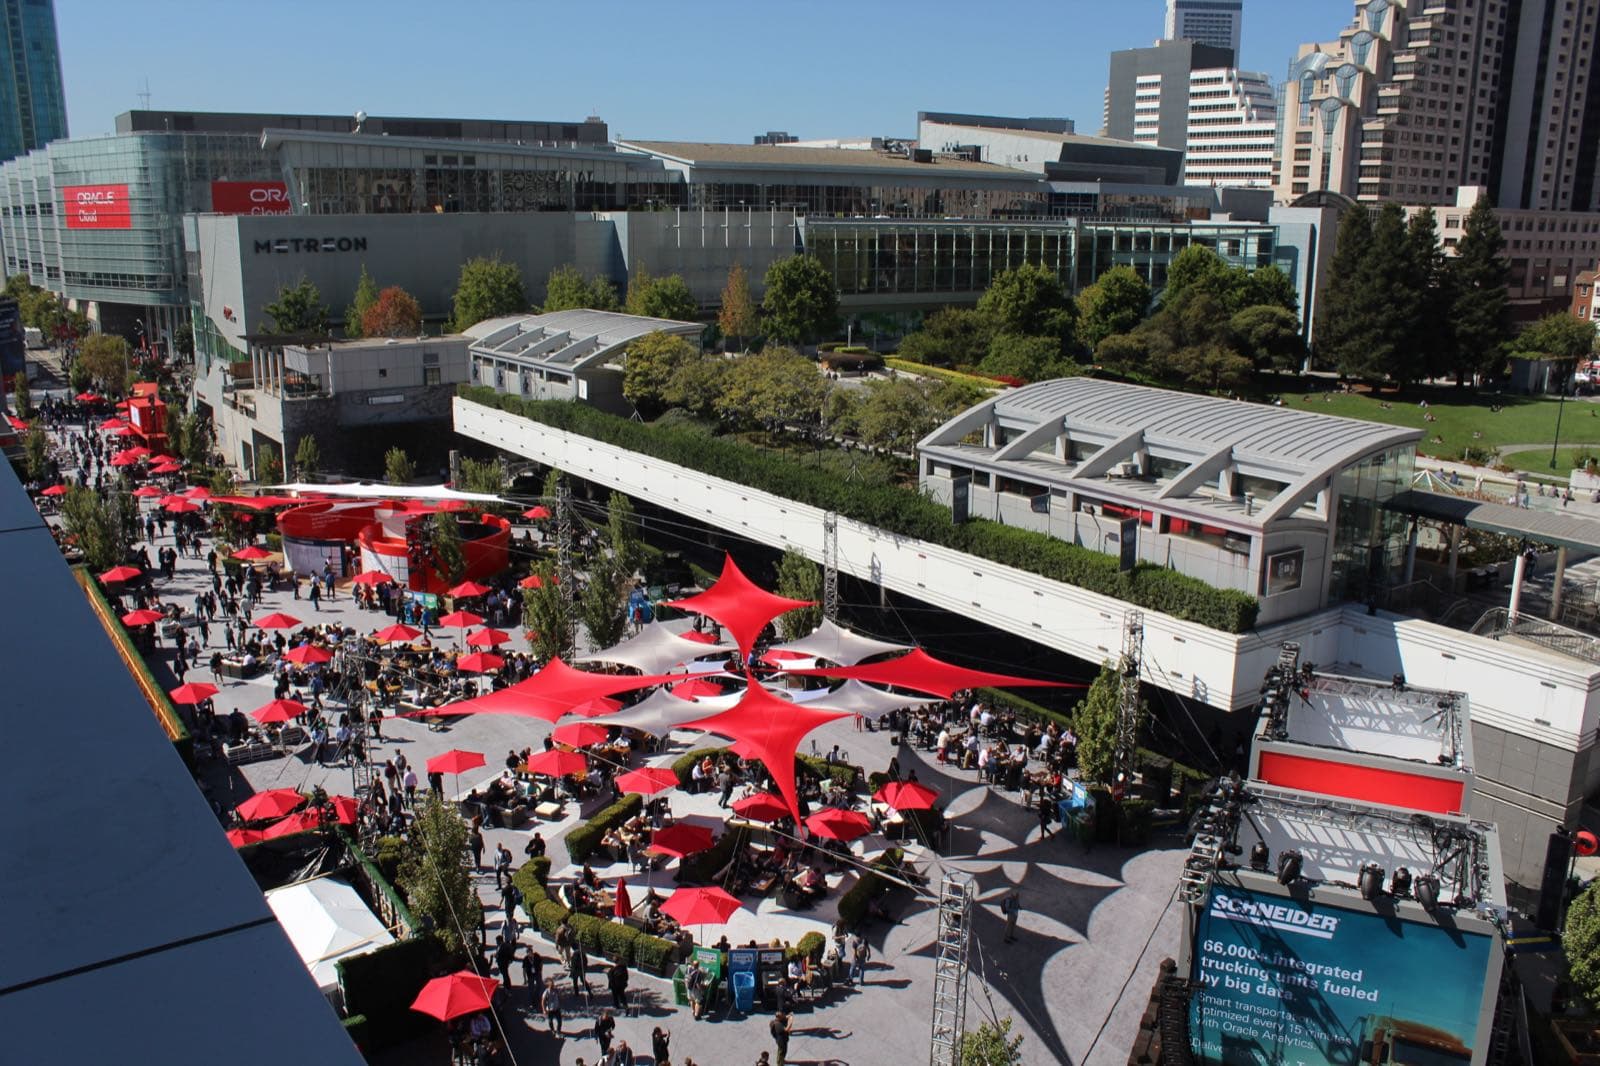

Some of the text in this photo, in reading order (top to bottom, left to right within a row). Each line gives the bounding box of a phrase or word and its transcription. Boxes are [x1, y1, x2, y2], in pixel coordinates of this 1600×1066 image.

[77, 191, 114, 204] ORACLE
[255, 237, 367, 254] METREON
[1213, 894, 1337, 931] SCHNEIDER
[1203, 939, 1363, 982] 66,000+ integrated
[1200, 970, 1296, 1001] by big data.
[1201, 956, 1378, 1002] trucking units fueled
[1199, 992, 1232, 1008] Smart
[1195, 1017, 1316, 1049] with Oracle Analytics.
[1196, 1006, 1250, 1023] optimized
[1253, 1017, 1284, 1032] every
[1290, 1023, 1302, 1034] 15
